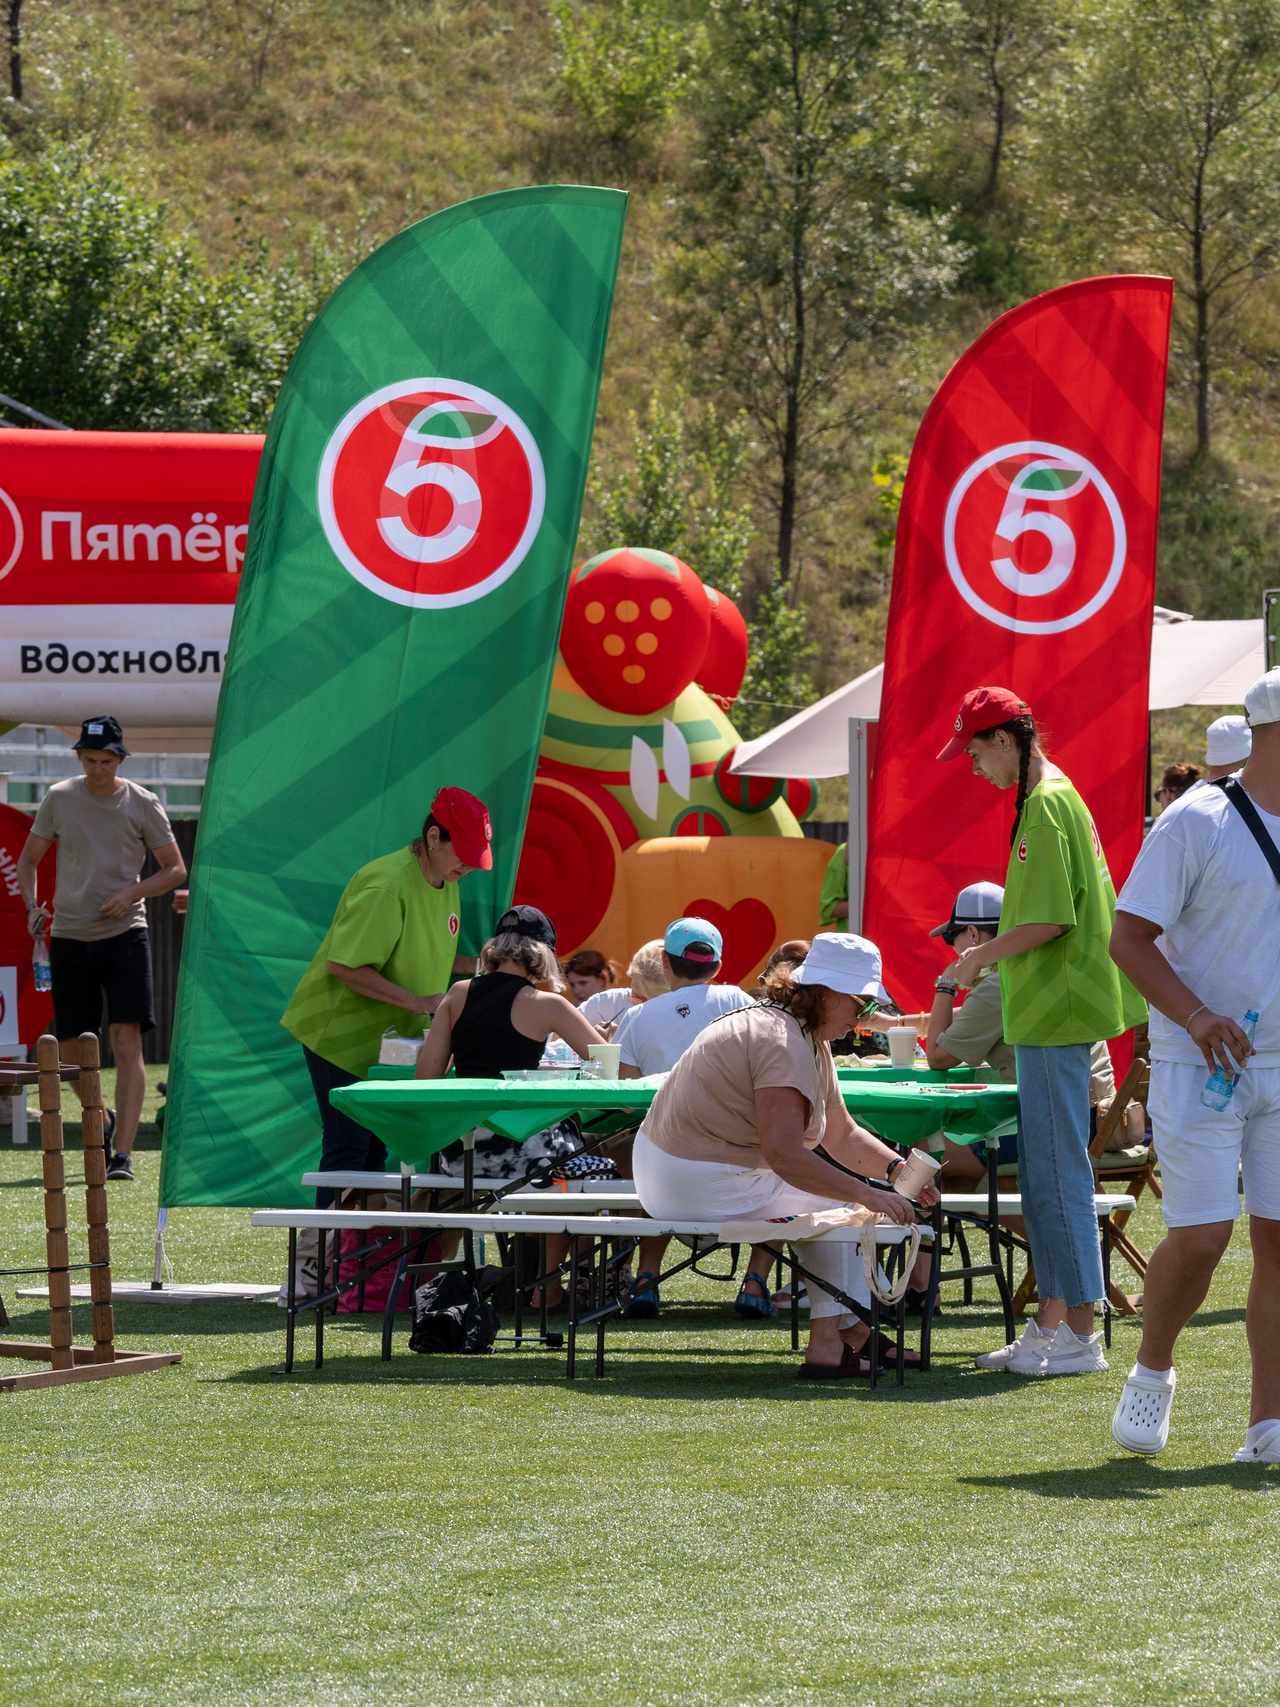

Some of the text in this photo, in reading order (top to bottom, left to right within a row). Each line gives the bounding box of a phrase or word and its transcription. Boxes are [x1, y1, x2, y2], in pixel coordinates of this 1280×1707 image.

[376, 399, 506, 563] 5
[990, 459, 1091, 597] 5
[21, 642, 228, 675] Вдохновл
